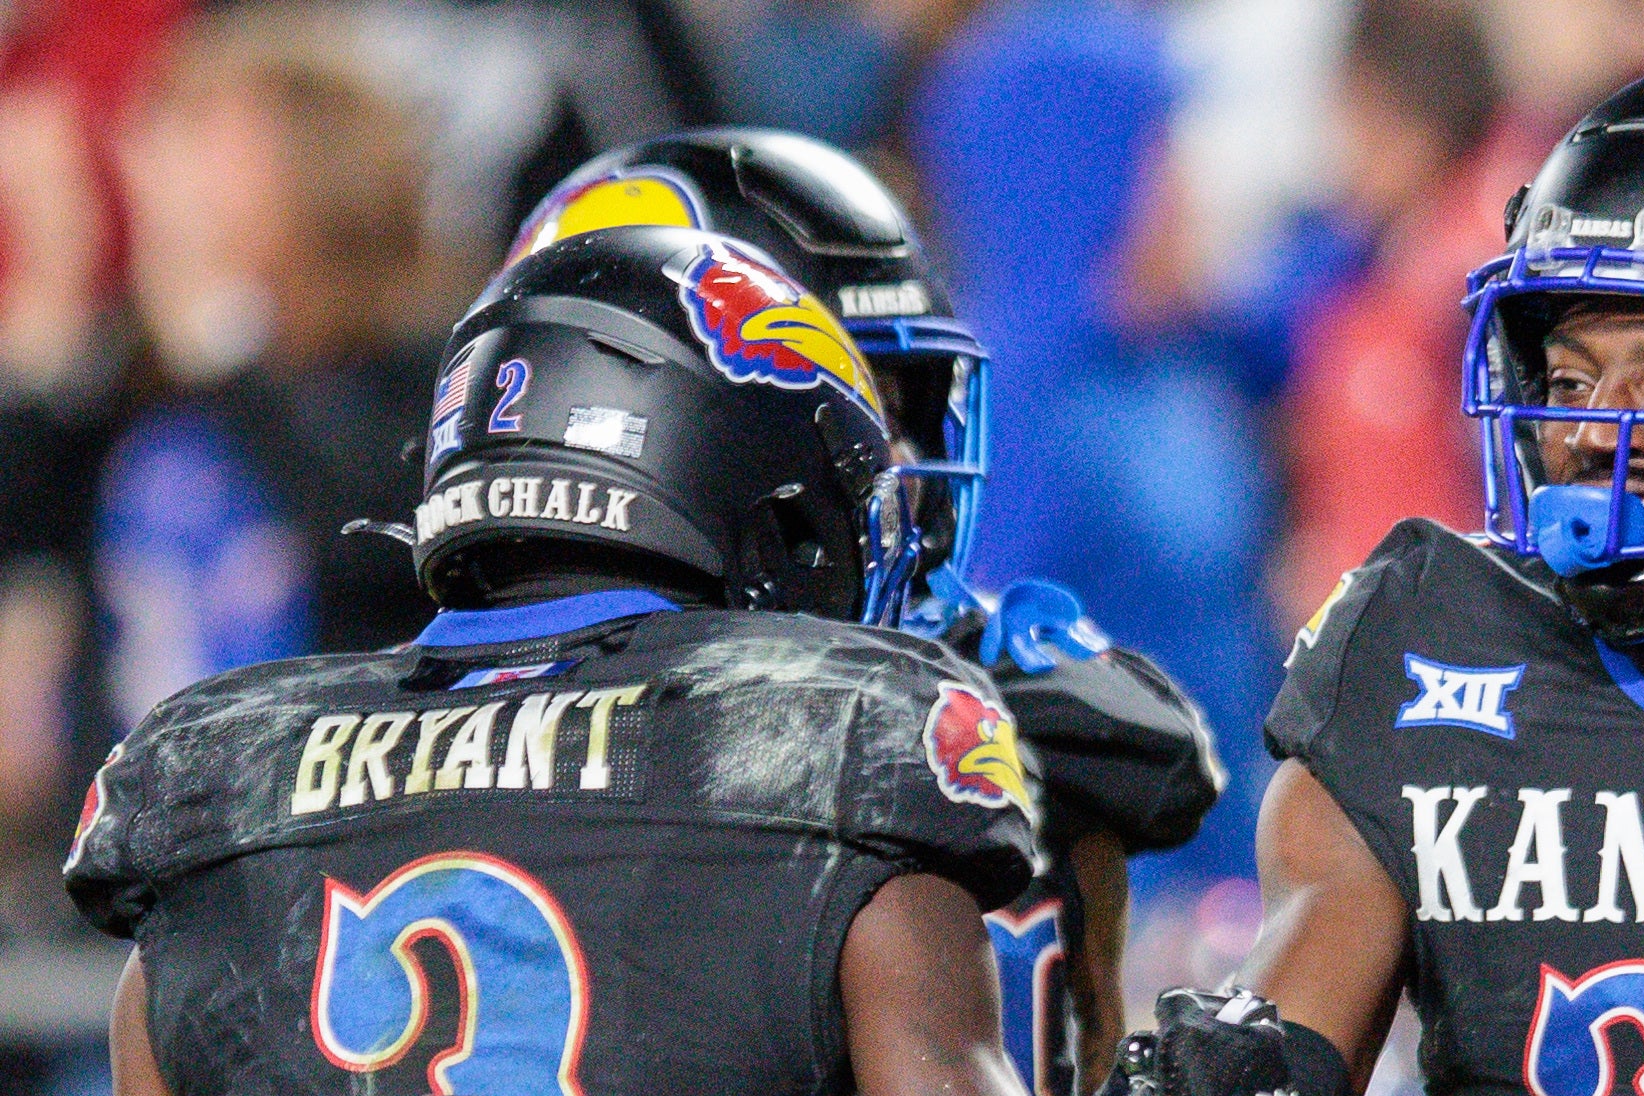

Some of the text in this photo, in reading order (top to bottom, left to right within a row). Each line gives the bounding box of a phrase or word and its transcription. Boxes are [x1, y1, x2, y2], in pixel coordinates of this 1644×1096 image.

[488, 358, 532, 433] 2
[487, 477, 638, 531] CHALK
[1398, 655, 1525, 737] XII
[290, 684, 648, 815] BRYANT
